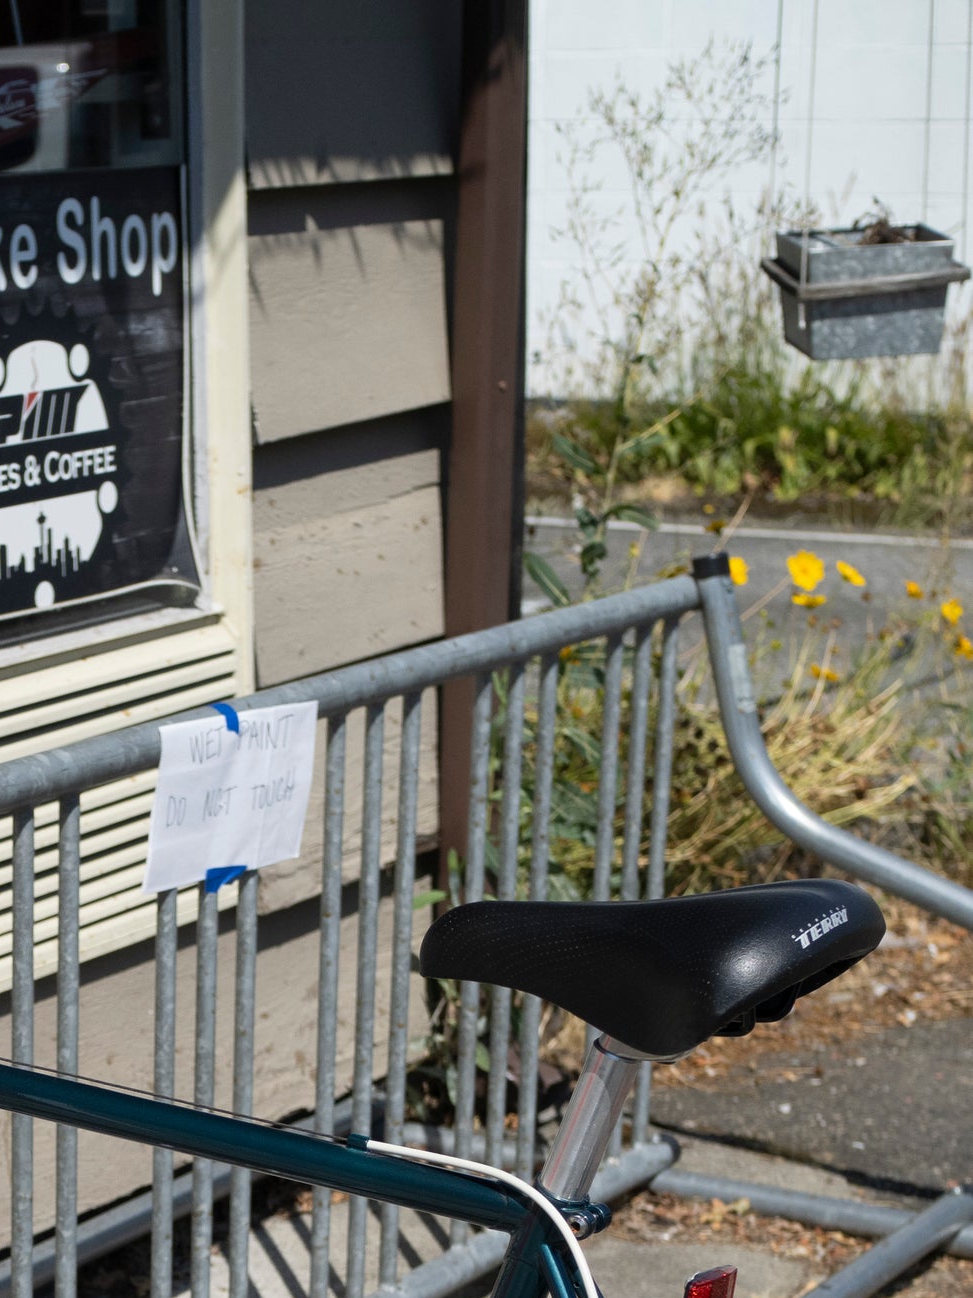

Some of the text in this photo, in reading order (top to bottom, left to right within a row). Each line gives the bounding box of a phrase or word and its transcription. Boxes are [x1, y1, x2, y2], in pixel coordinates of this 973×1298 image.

[57, 197, 177, 296] Shop
[24, 455, 42, 487] &
[44, 446, 117, 483] COFFEE
[188, 713, 295, 765] WET PAINT
[165, 765, 298, 828] DO NOT TOUCH
